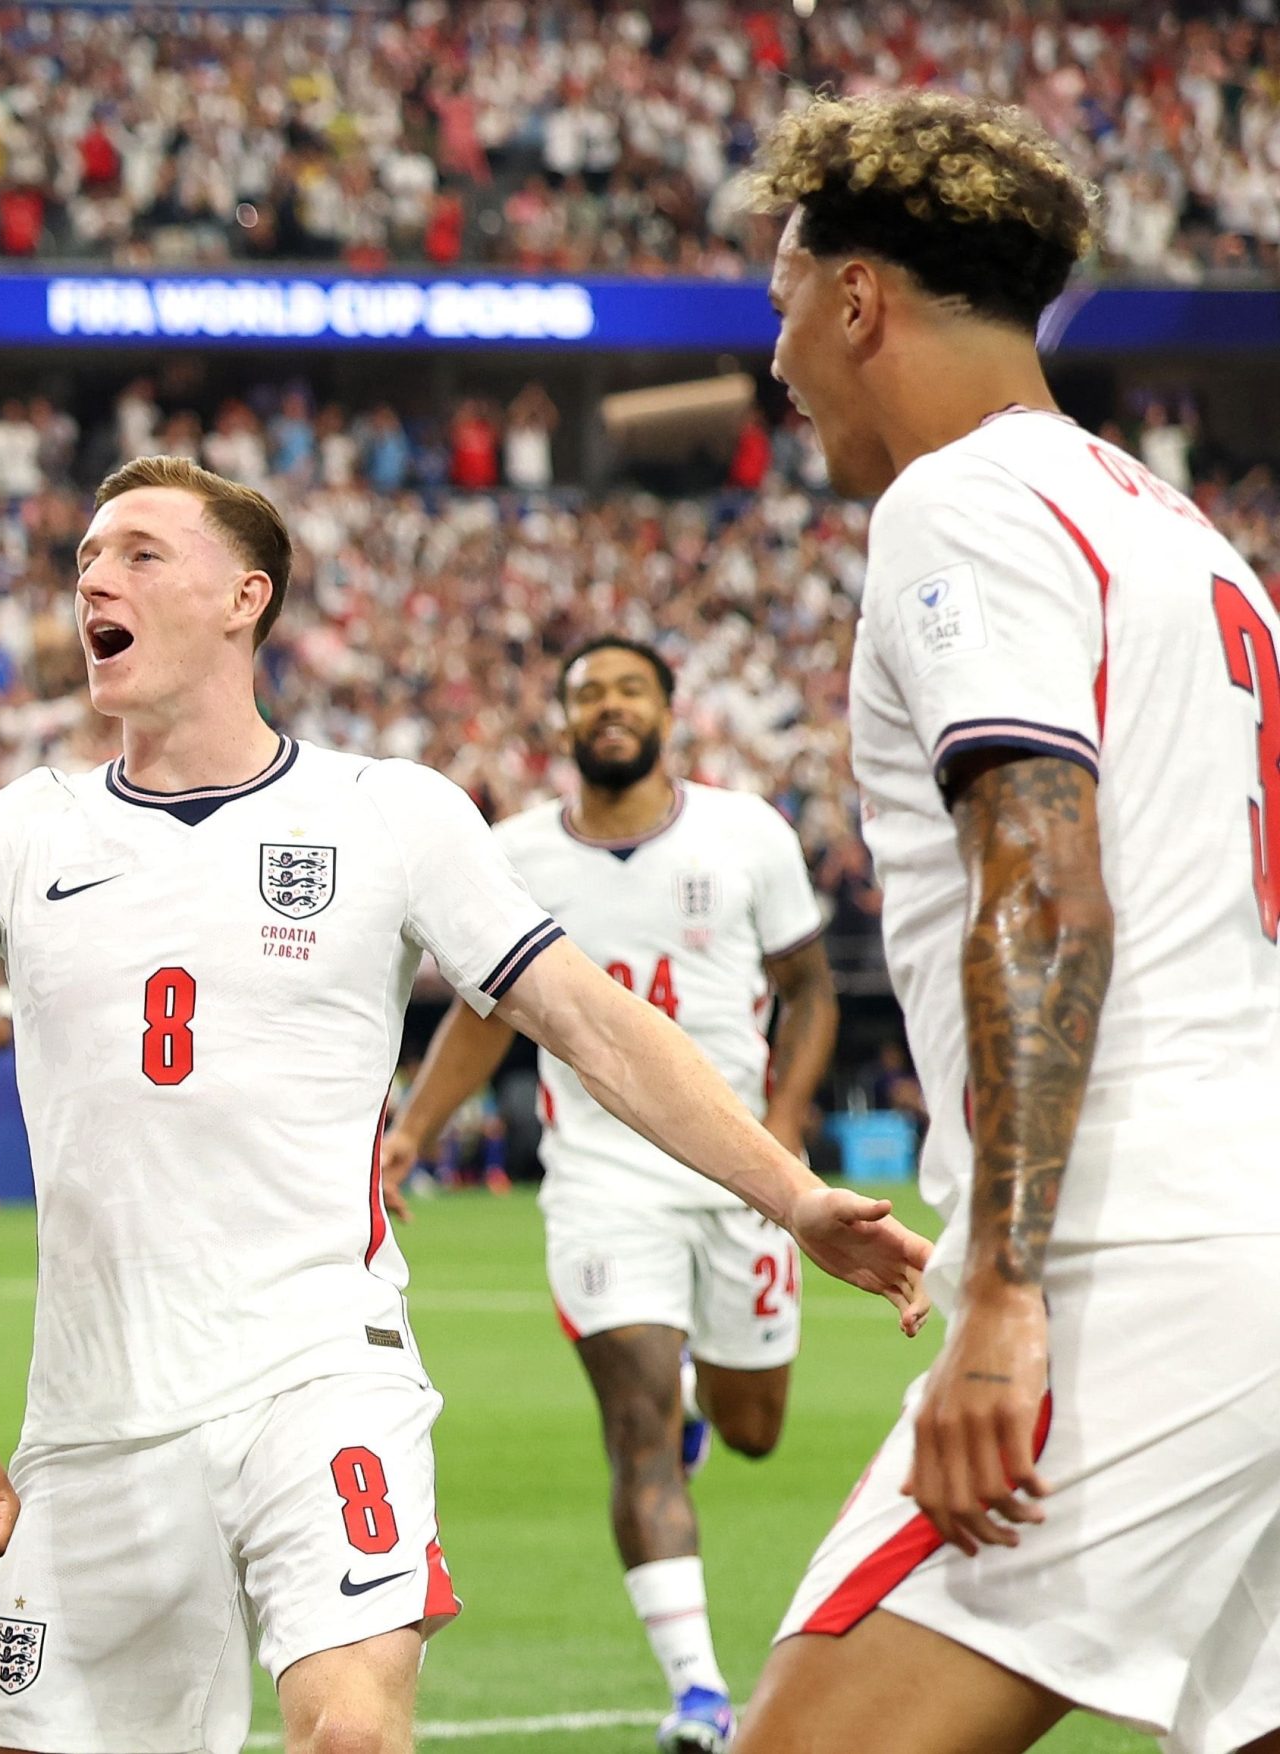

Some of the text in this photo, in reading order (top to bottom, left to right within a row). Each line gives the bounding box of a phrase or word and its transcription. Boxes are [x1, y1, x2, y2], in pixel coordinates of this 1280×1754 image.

[47, 280, 596, 339] FIFA WORLD CUP 2026
[261, 925, 317, 945] CROATIA
[263, 942, 310, 961] 17.06.26
[142, 967, 196, 1085] 8
[754, 1242, 799, 1318] 24
[330, 1445, 400, 1555] 8
